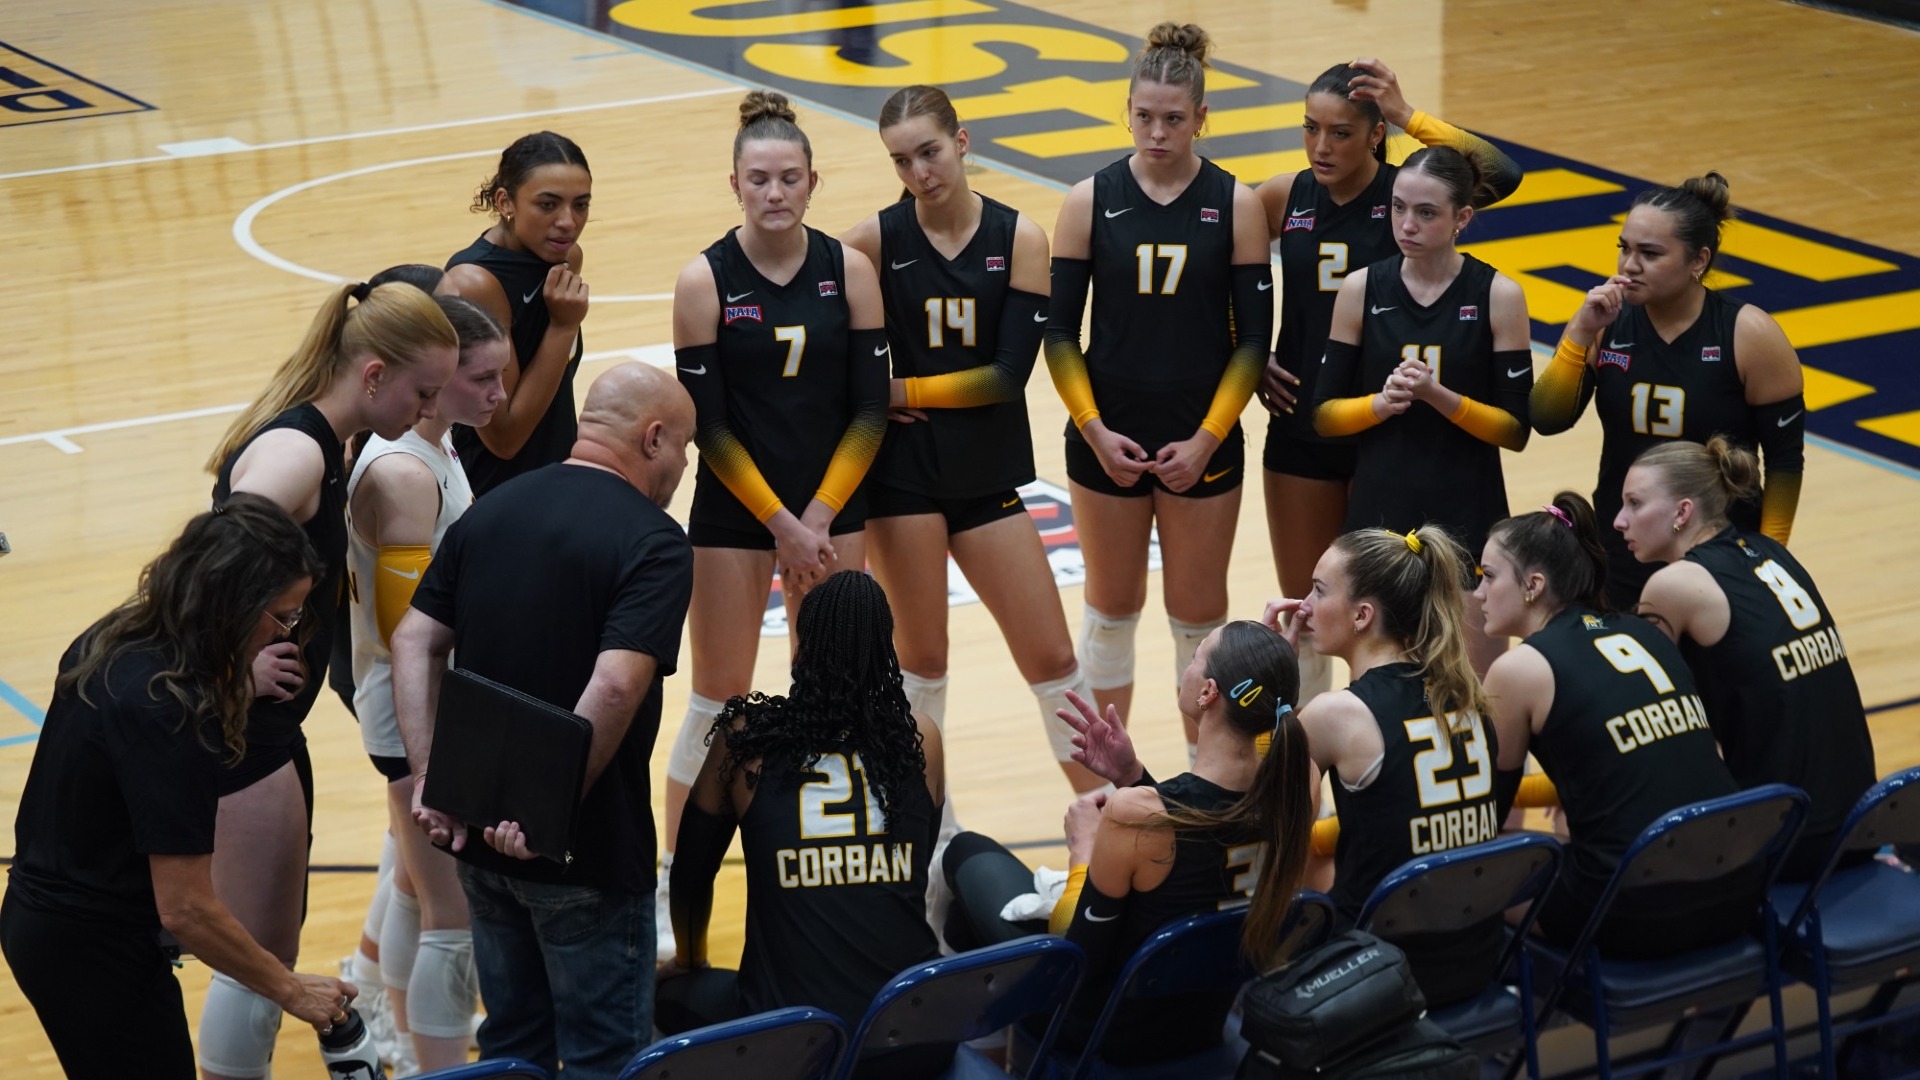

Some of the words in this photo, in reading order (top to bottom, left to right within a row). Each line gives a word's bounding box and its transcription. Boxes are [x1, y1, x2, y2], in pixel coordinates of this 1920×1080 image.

[1286, 217, 1314, 230] NAIA
[1135, 243, 1188, 295] 17
[1318, 242, 1348, 291] 2
[726, 306, 761, 321] NAIA
[925, 297, 977, 348] 14
[774, 324, 806, 377] 7
[1600, 350, 1630, 370] NAIA
[1631, 382, 1685, 437] 13
[1754, 558, 1822, 630] 8
[1594, 633, 1676, 695] 9
[1403, 709, 1491, 809] 23
[776, 842, 913, 889] CORBAN
[1306, 949, 1381, 993] MUELLER
